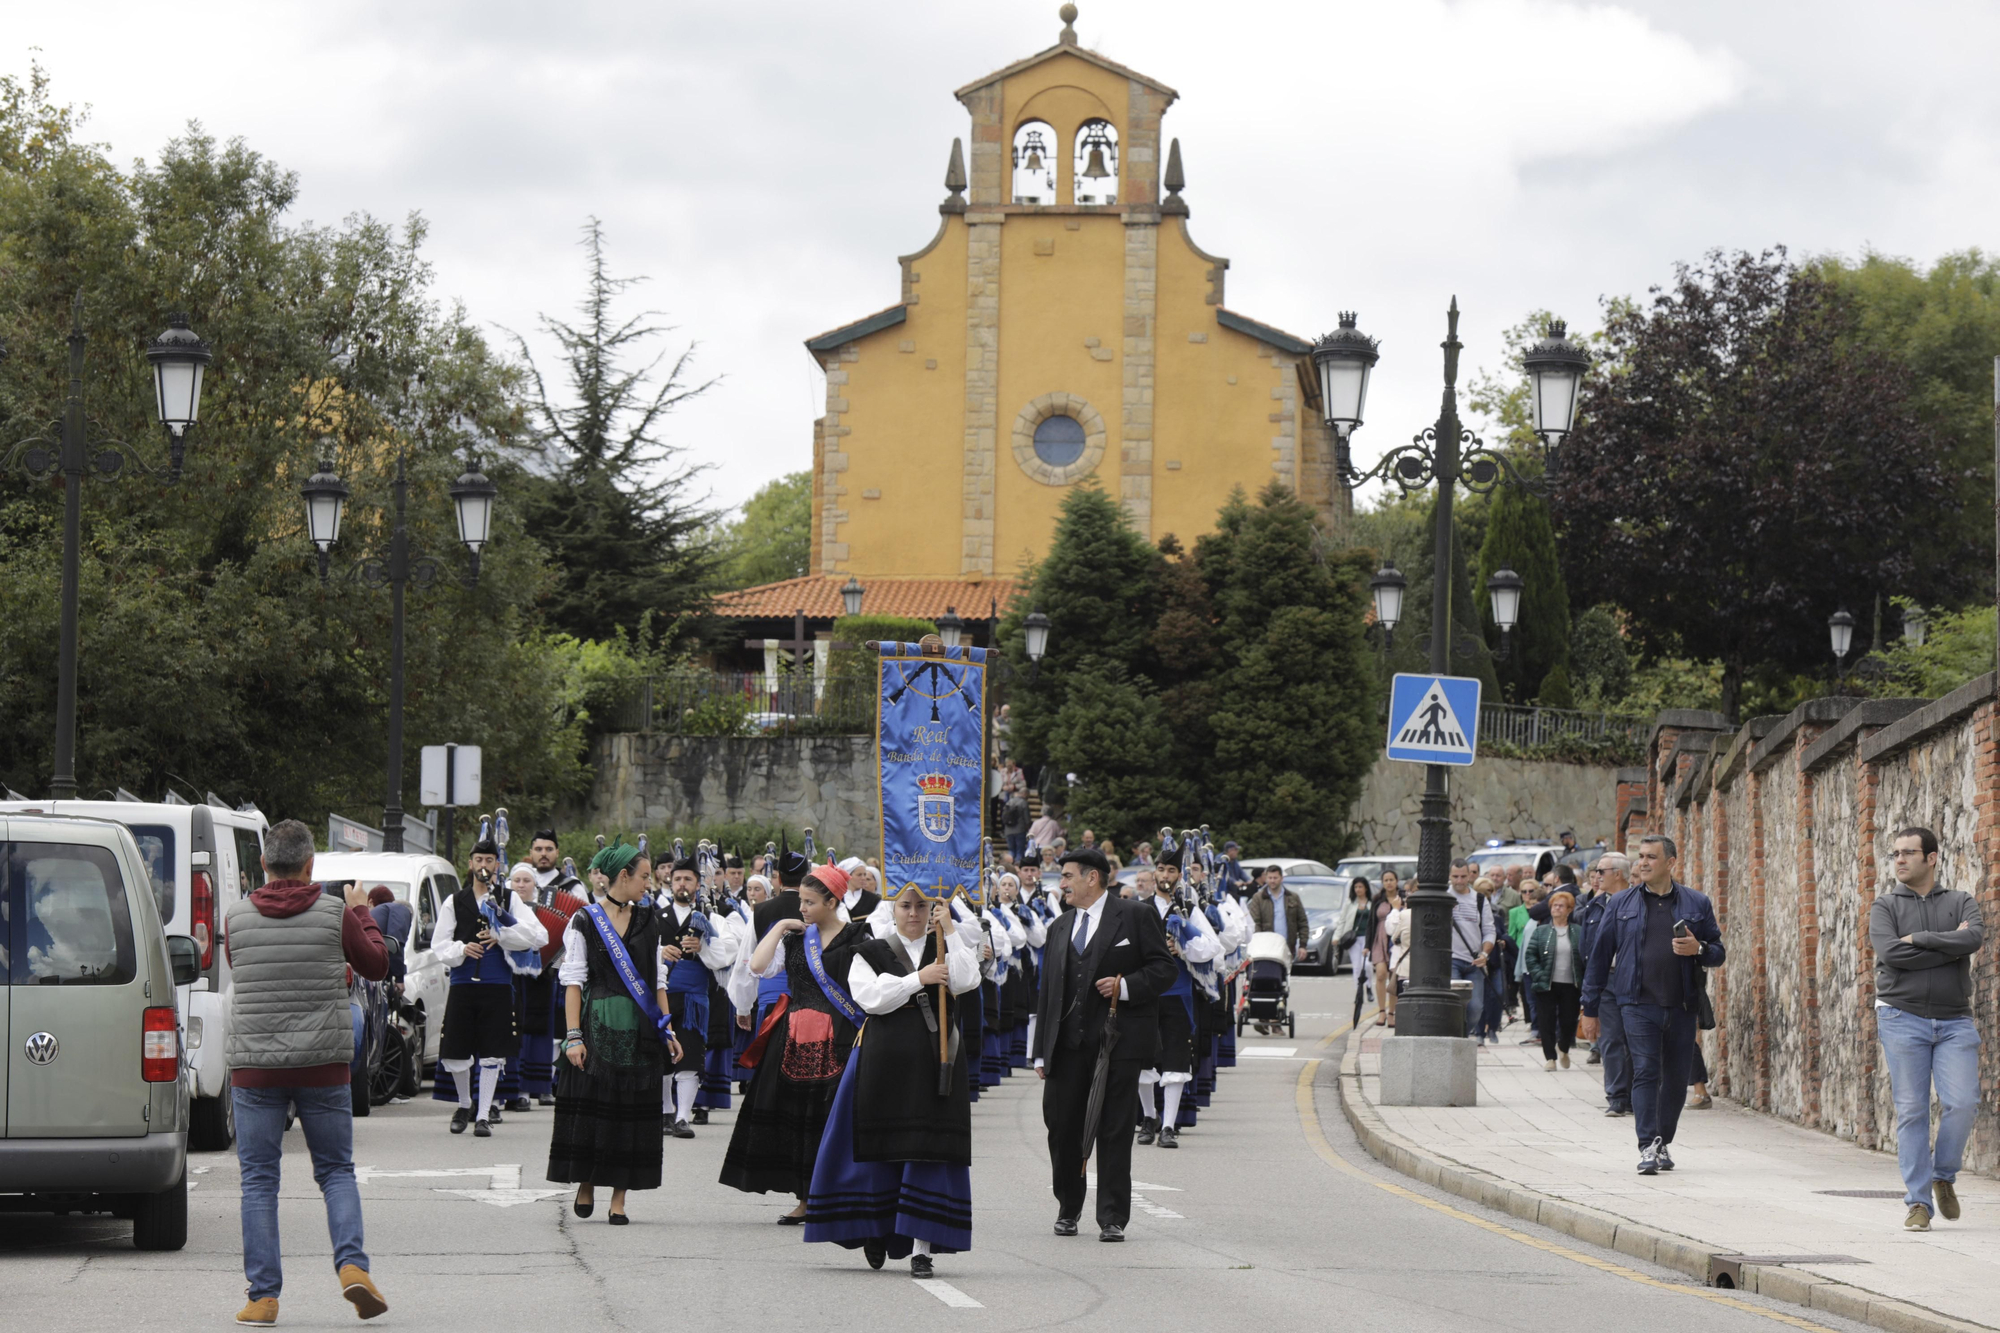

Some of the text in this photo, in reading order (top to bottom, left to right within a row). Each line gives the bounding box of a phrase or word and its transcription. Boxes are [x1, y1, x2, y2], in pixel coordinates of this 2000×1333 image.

[913, 725, 952, 746] Real
[887, 748, 979, 768] Banda de Gaitas
[891, 850, 976, 869] Ciudad de Oviedo
[596, 916, 609, 932] SAN
[606, 933, 622, 958] MATEO
[621, 961, 635, 981] OVIEDO
[632, 981, 644, 996] 2022
[814, 960, 827, 983] MATEO
[828, 985, 845, 1003] OVIEDO
